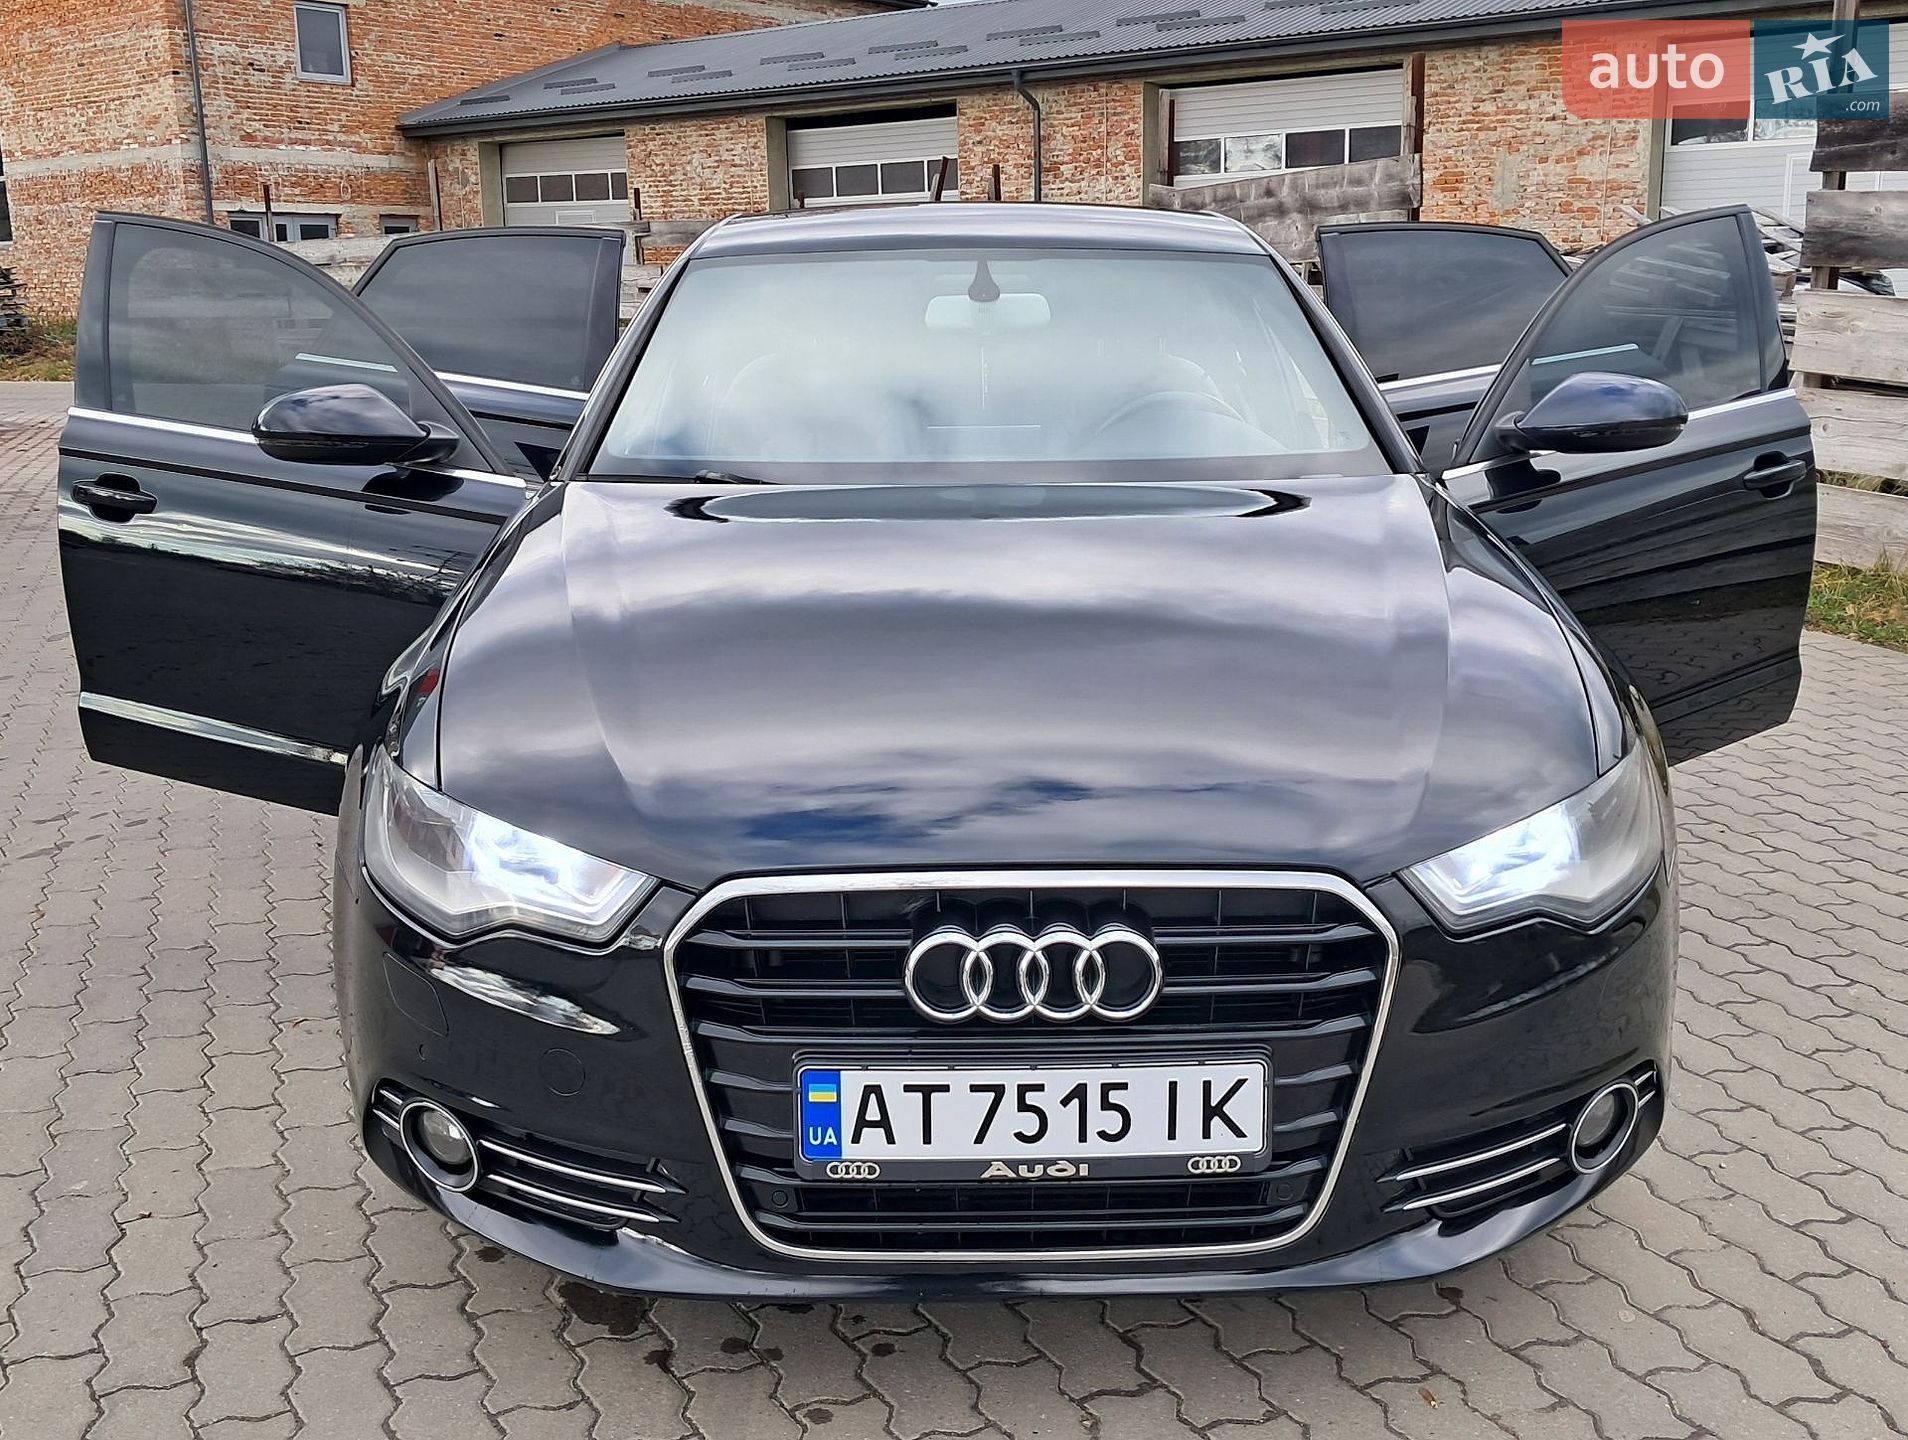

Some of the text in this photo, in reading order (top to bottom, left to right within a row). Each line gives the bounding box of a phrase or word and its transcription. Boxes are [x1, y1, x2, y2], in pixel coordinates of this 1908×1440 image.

[851, 1083, 950, 1145] AT
[969, 1082, 1132, 1145] 7515
[809, 1127, 838, 1146] UA
